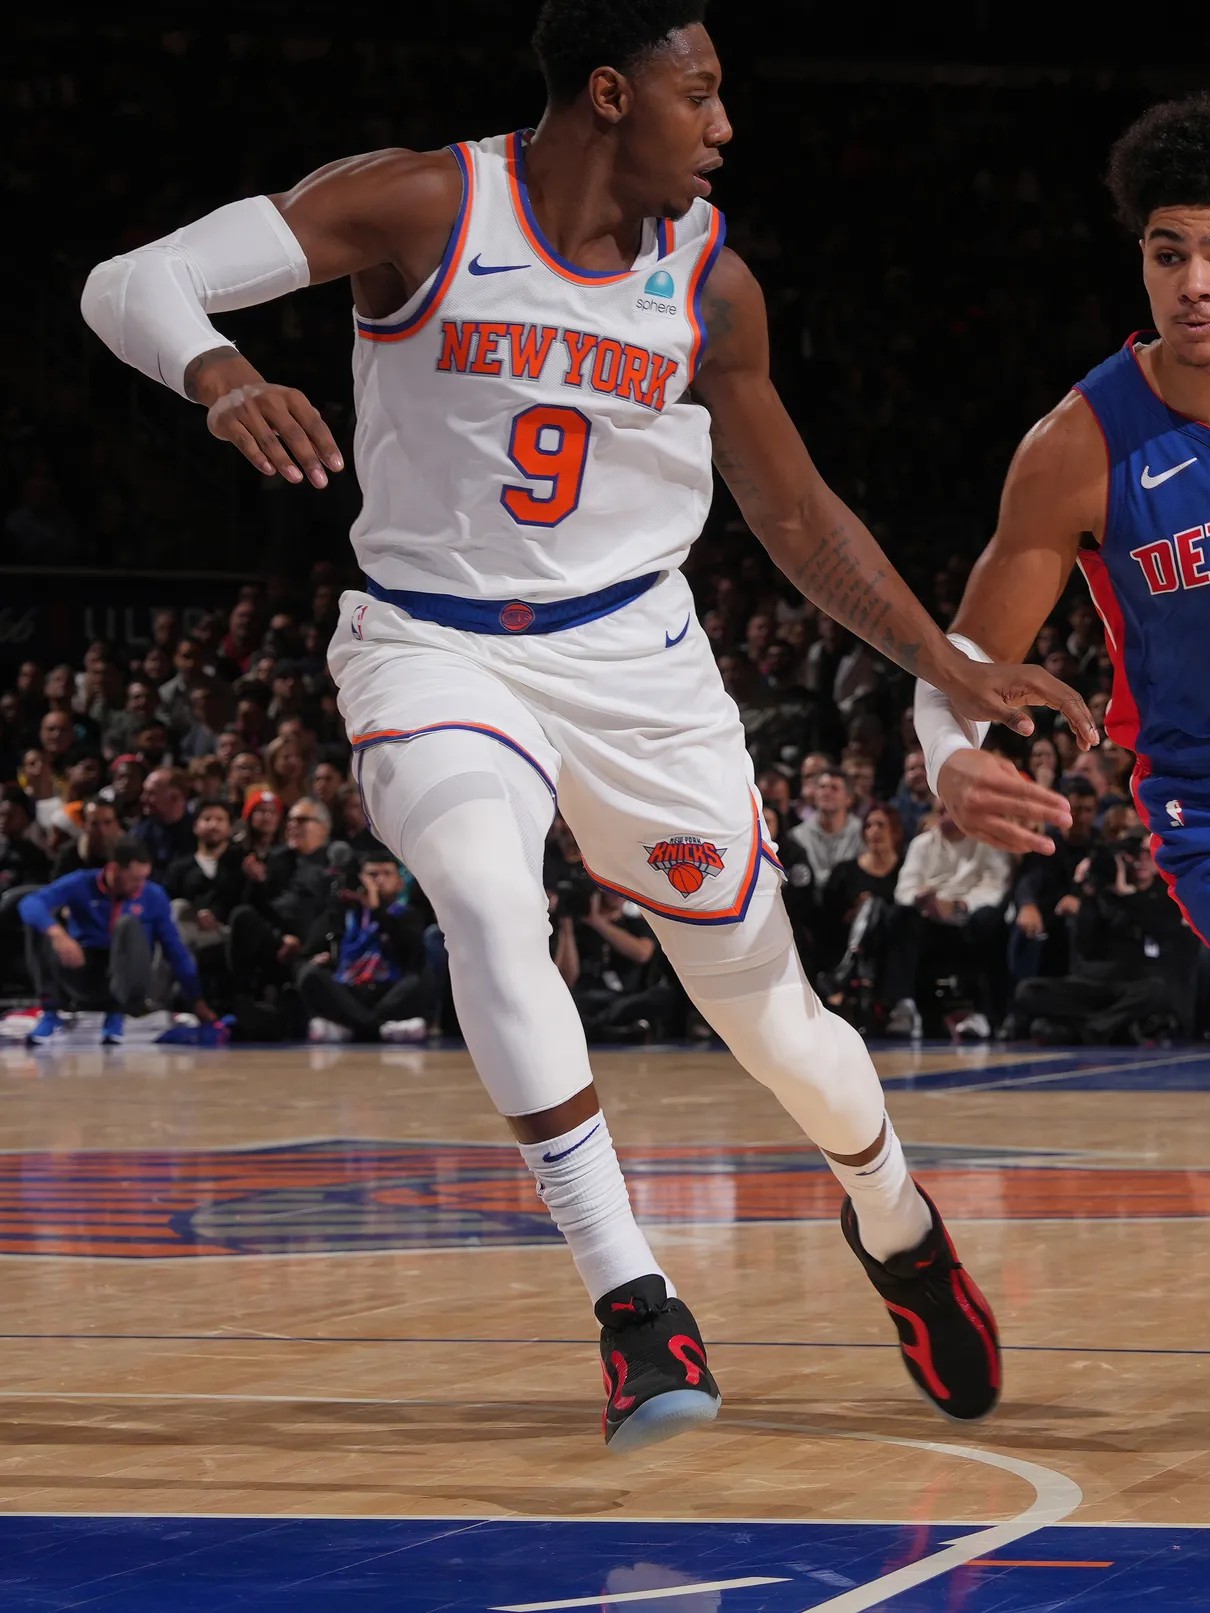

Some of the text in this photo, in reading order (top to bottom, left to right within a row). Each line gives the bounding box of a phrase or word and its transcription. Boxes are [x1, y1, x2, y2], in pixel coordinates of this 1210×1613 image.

[635, 297, 677, 316] sphere
[435, 319, 680, 415] NEW YORK
[499, 403, 593, 528] 9
[647, 841, 725, 869] KNICKS
